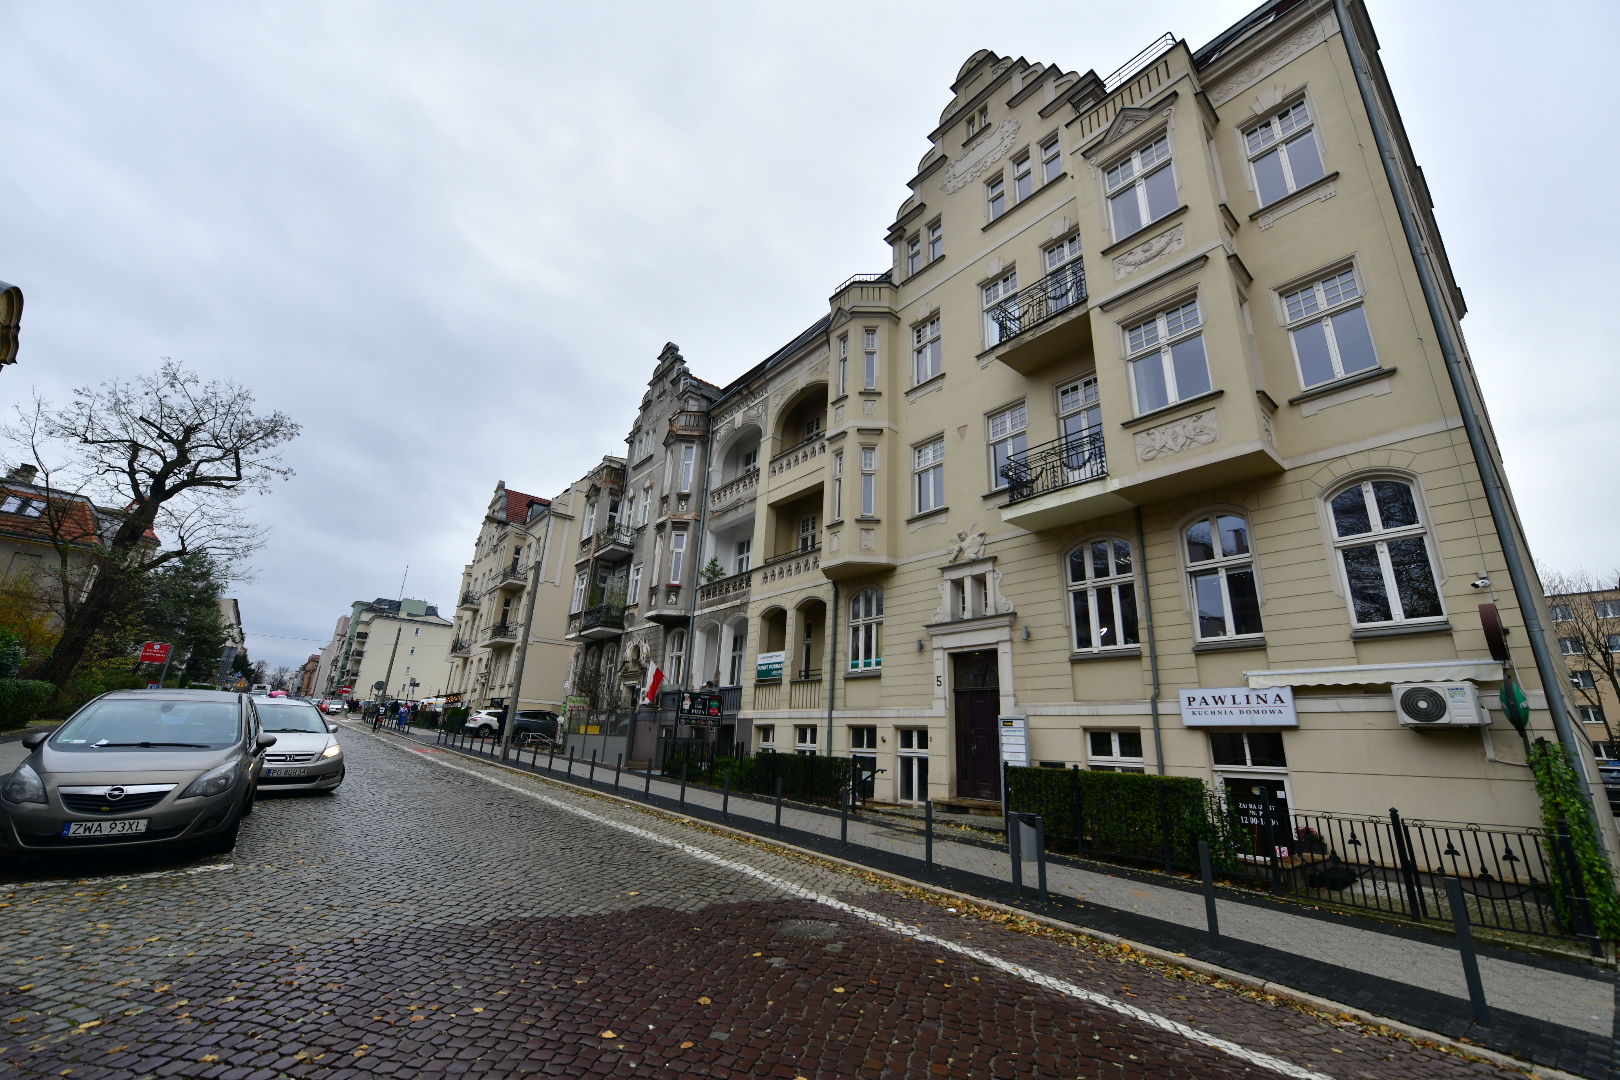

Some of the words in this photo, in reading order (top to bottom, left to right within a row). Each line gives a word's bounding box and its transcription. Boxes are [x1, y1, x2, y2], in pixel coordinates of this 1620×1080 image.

[936, 675, 942, 687] 5
[1187, 693, 1285, 706] PAWLINA
[71, 822, 103, 835] ZWA
[108, 821, 142, 833] 93XL
